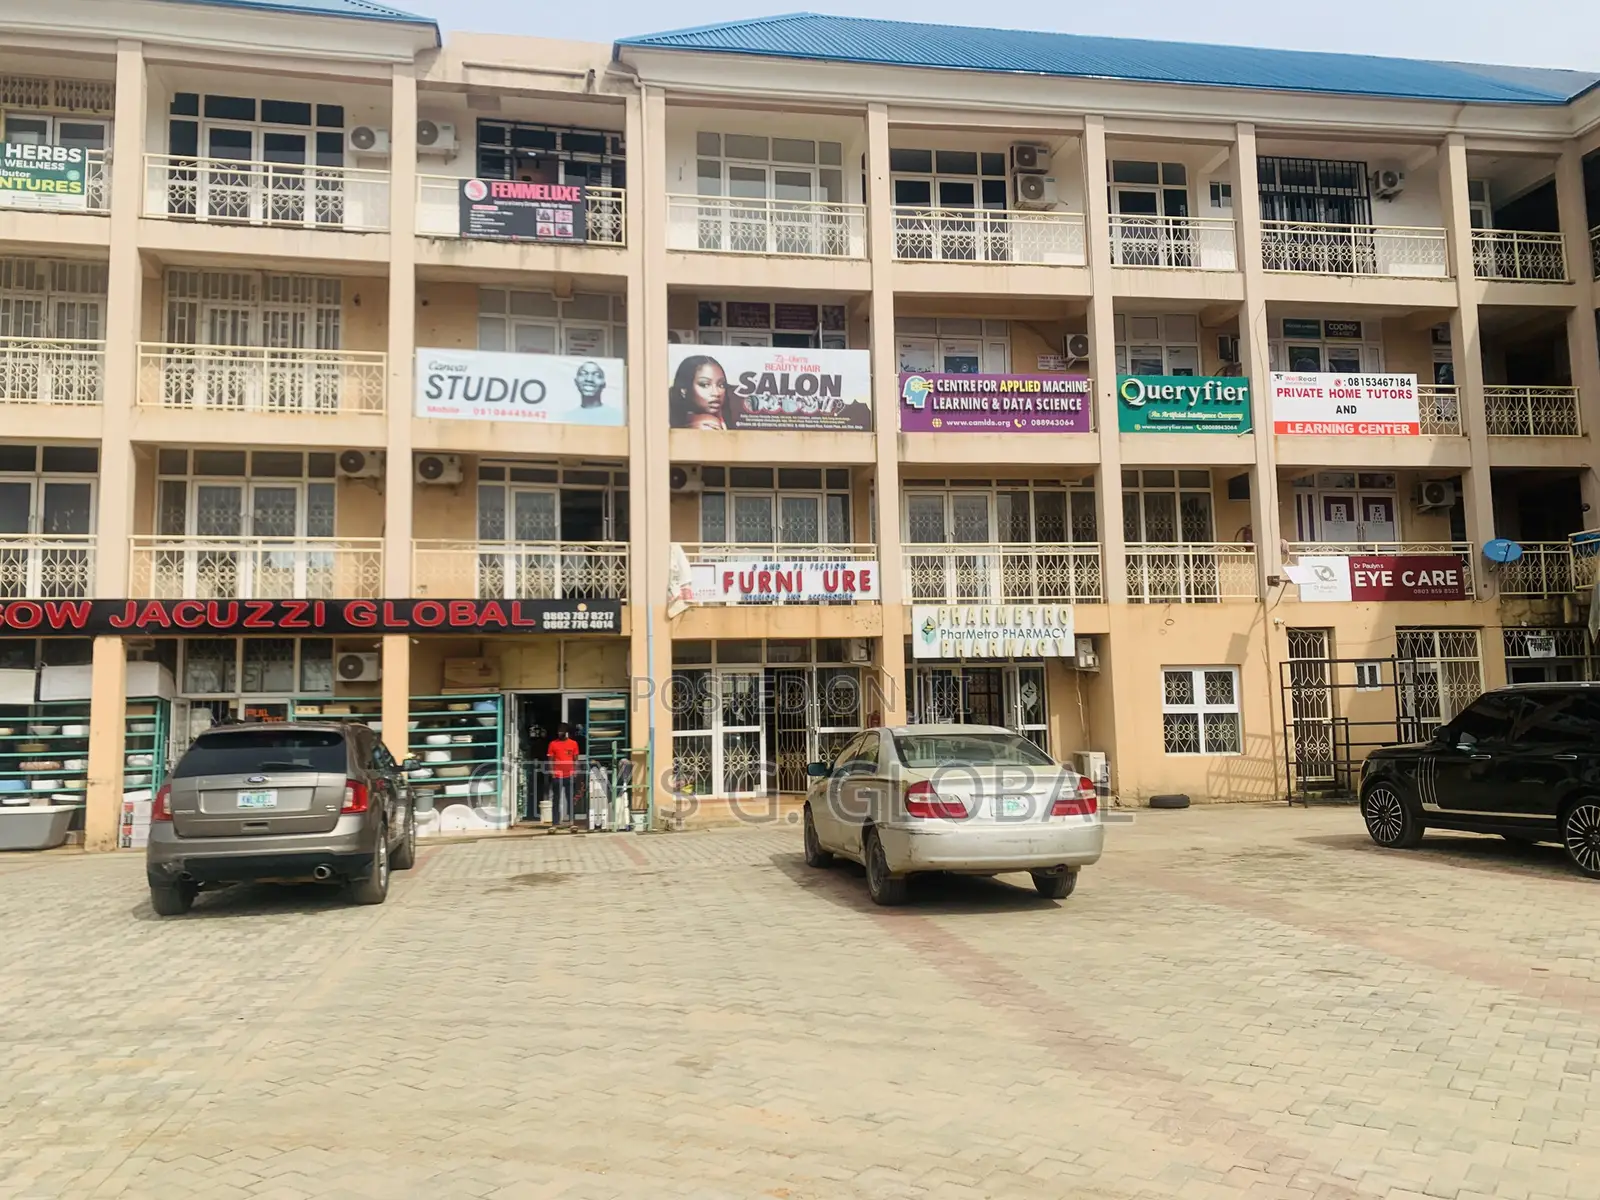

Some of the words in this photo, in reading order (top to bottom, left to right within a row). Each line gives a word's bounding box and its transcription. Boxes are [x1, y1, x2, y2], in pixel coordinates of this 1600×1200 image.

[5, 142, 82, 163] HERBS
[4, 158, 65, 171] WELLNESS
[491, 182, 581, 202] FEMMELUXE
[765, 363, 798, 373] BEAUTY
[800, 364, 821, 374] HAIR
[425, 374, 547, 405] STUDIO
[737, 371, 842, 398] SALON
[937, 379, 976, 392] CENTRE
[977, 379, 997, 392] FOR
[1000, 379, 1041, 393] APPLIED
[1042, 380, 1088, 393] MACHINE
[1121, 377, 1248, 406] Queryfier
[1276, 387, 1323, 398] PRIVATE
[1329, 388, 1361, 399] HOME
[1366, 389, 1413, 400] TUTORS
[933, 396, 988, 410] LEARNING
[991, 397, 1000, 409] &
[1003, 397, 1032, 411] DATA
[1036, 397, 1082, 411] SCIENCE
[1336, 405, 1357, 414] AND
[946, 418, 1011, 428] www.camlds.org
[1217, 411, 1244, 421] Company
[1287, 423, 1354, 434] LEARNING
[1358, 423, 1411, 434] CENTER
[1354, 570, 1394, 587] EYE
[1401, 570, 1459, 587] CARE
[0, 600, 93, 629] OW
[109, 599, 325, 628] JACUZZI
[343, 600, 536, 628] GLOBAL
[543, 611, 571, 620] 0803
[572, 611, 589, 620] 787
[591, 611, 614, 620] 8217
[937, 606, 1070, 627] PHARMETRO
[543, 620, 571, 629] 0802
[940, 627, 1000, 640] PharMetro
[1002, 627, 1068, 640] PHARMACY
[941, 638, 1066, 658] PHARMACY
